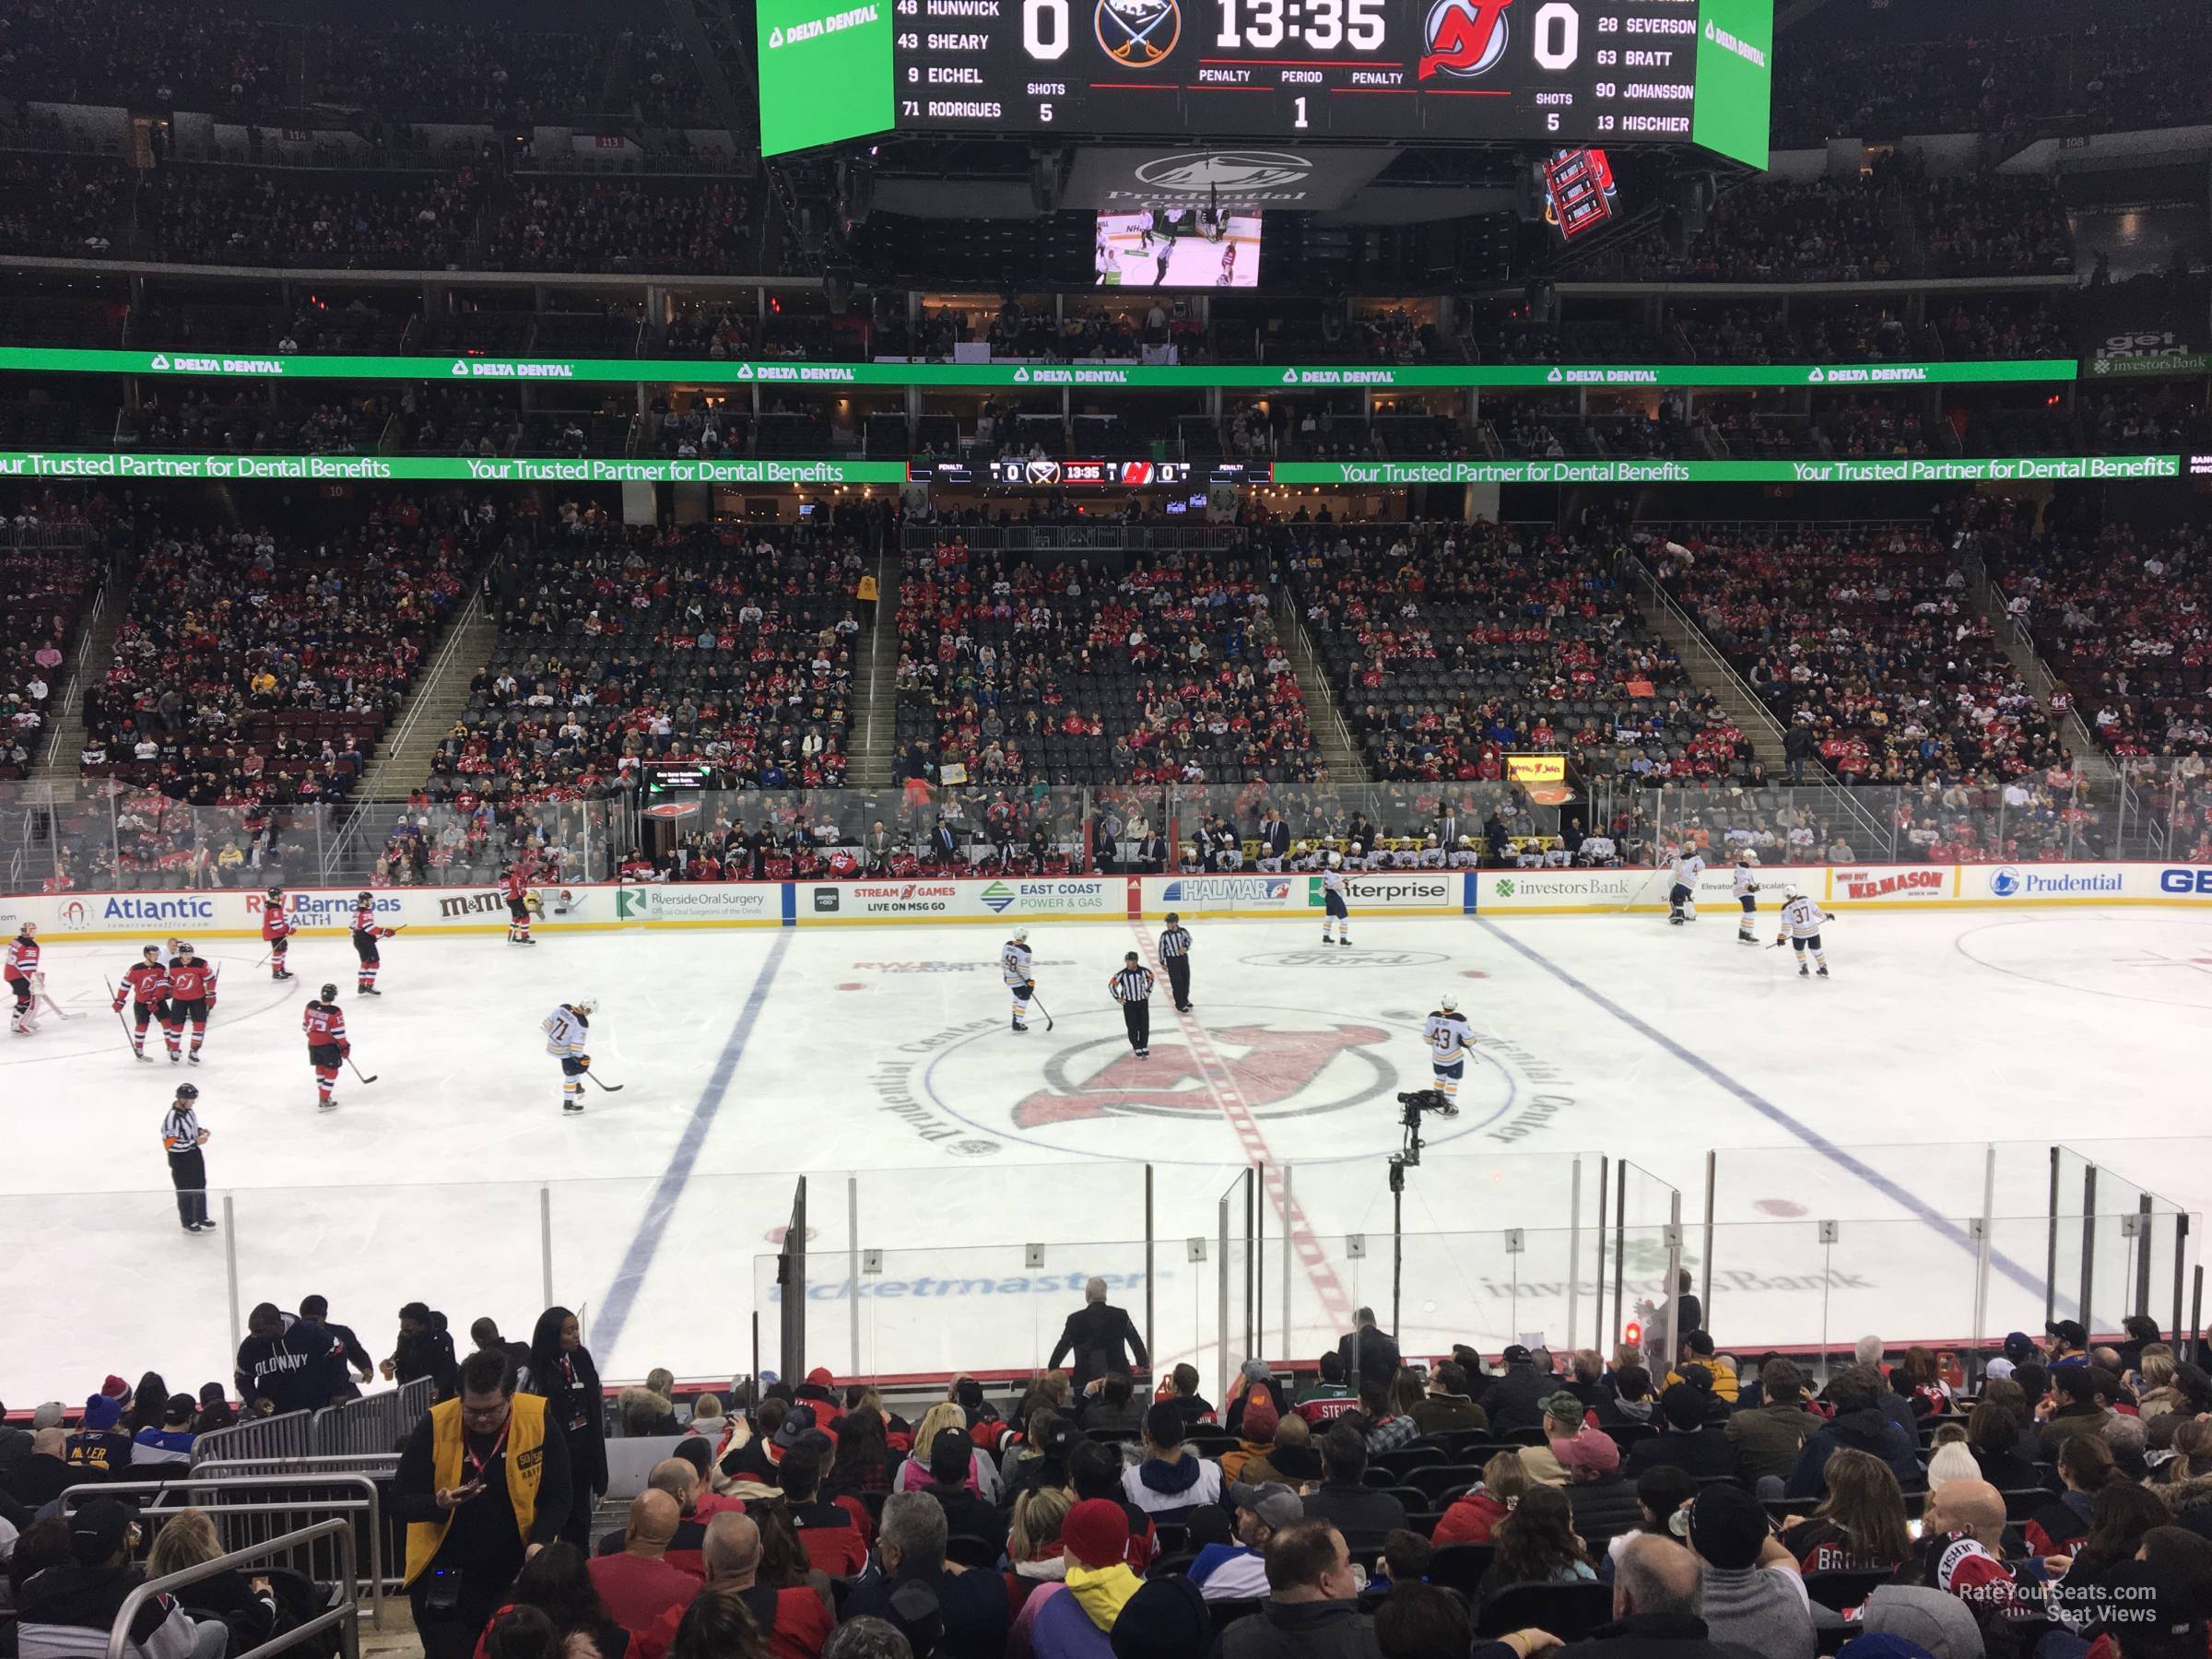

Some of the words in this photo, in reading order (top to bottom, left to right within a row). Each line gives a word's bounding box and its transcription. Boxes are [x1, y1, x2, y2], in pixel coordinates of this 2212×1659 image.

[898, 0, 918, 15] 48
[927, 0, 1000, 16] HUNWICK
[786, 20, 824, 44] DELTA
[825, 5, 878, 34] DENTAL
[1023, 0, 1069, 60] 0
[1218, 0, 1385, 50] 13:35
[1598, 18, 1618, 32] 28
[1626, 18, 1697, 34] SEVERSON
[897, 33, 919, 49] 43
[927, 34, 989, 50] SHEARY
[1534, 2, 1579, 70] 0
[1715, 28, 1737, 53] DELTA
[1737, 40, 1765, 67] DENTAL
[1597, 50, 1618, 65] 63
[1625, 51, 1673, 66] BRATT
[908, 67, 919, 83] 9
[928, 67, 983, 84] EICHEL
[1199, 69, 1252, 82] PENALTY
[1281, 71, 1324, 84] PERIOD
[1351, 72, 1404, 85] PENALTY
[1027, 83, 1066, 96] SHOTS
[1595, 82, 1616, 98] 90
[1623, 84, 1694, 100] JOHANSSON
[1535, 93, 1573, 105] SHOTS
[902, 100, 920, 116] 71
[928, 100, 1002, 118] RODRIGUES
[1040, 103, 1053, 122] 5
[1294, 96, 1309, 128] 1
[1547, 112, 1560, 132] 5
[1597, 115, 1615, 131] 13
[1622, 116, 1690, 133] HISCHIER
[1107, 191, 1306, 200] Prudential
[1140, 200, 1260, 209] Cener
[2105, 331, 2176, 351] get
[174, 359, 221, 371] DELTA
[223, 360, 280, 373] DENTAL
[472, 363, 515, 376] DELTA
[518, 365, 571, 377] DENTAL
[2113, 357, 2207, 372] investorsBank
[757, 367, 798, 380] DELTA
[800, 368, 853, 381] DENTAL
[1033, 370, 1073, 382] DELTA
[1075, 371, 1126, 382] DENTAL
[1301, 371, 1341, 382] DELTA
[1343, 371, 1393, 383] DENTAL
[1566, 371, 1605, 382] DELTA
[1606, 371, 1656, 382] DENTAL
[1828, 369, 1869, 382] DELTA
[1871, 369, 1925, 381] DENTAL
[0, 459, 26, 474] ur
[28, 454, 115, 475] Trusted
[121, 456, 200, 476] Partner
[205, 456, 234, 477] for
[238, 457, 307, 477] Dental
[312, 458, 391, 478] Benefits
[2191, 455, 2212, 465] RAN
[467, 460, 512, 479] Your
[513, 461, 589, 479] Trusted
[594, 462, 665, 480] Partner
[668, 461, 696, 481] for
[699, 462, 763, 481] Dental
[768, 462, 843, 482] Benefits
[1007, 465, 1018, 480] 0
[1067, 466, 1100, 479] 13:35
[1162, 465, 1173, 480] 0
[1341, 464, 1381, 482] Your
[1383, 464, 1452, 482] Trusted
[1456, 464, 1524, 481] Partner
[1526, 462, 1551, 481] for
[1554, 462, 1614, 481] Dental
[1618, 462, 1689, 481] Benefits
[1794, 463, 1833, 481] Your
[1834, 462, 1908, 480] Trusted
[1912, 461, 1985, 479] Partner
[1988, 459, 2016, 478] for
[2018, 458, 2087, 478] Dental
[2090, 457, 2176, 477] Benefits
[1836, 874, 1853, 882] WHO
[2025, 873, 2124, 892] Prudential
[854, 888, 900, 898] STREAM
[917, 888, 956, 897] GAMES
[1020, 885, 1054, 895] EAST
[1058, 884, 1103, 894] COAST
[1182, 879, 1268, 901] HALMAR
[1521, 878, 1630, 895] investorsBank
[246, 894, 402, 914] RJBarnaas
[699, 893, 721, 904] Oral
[723, 894, 764, 906] Surgery
[867, 903, 889, 912] LIVE
[891, 902, 907, 911] ON
[908, 902, 929, 912] MSG
[931, 902, 946, 911] GO
[1020, 899, 1065, 908] POWER
[1067, 899, 1076, 908] &
[1077, 898, 1103, 908] GAS
[104, 896, 214, 920] Atlantic
[1792, 906, 1810, 924] 37
[281, 913, 331, 925] EALTH
[1278, 952, 1414, 967] Ford
[549, 1017, 570, 1041] 71
[898, 1016, 1006, 1053] Center
[1431, 1027, 1452, 1050] 43
[868, 1060, 965, 1142] Prudential
[1485, 1094, 1576, 1144] Center
[255, 1358, 276, 1377] OLD
